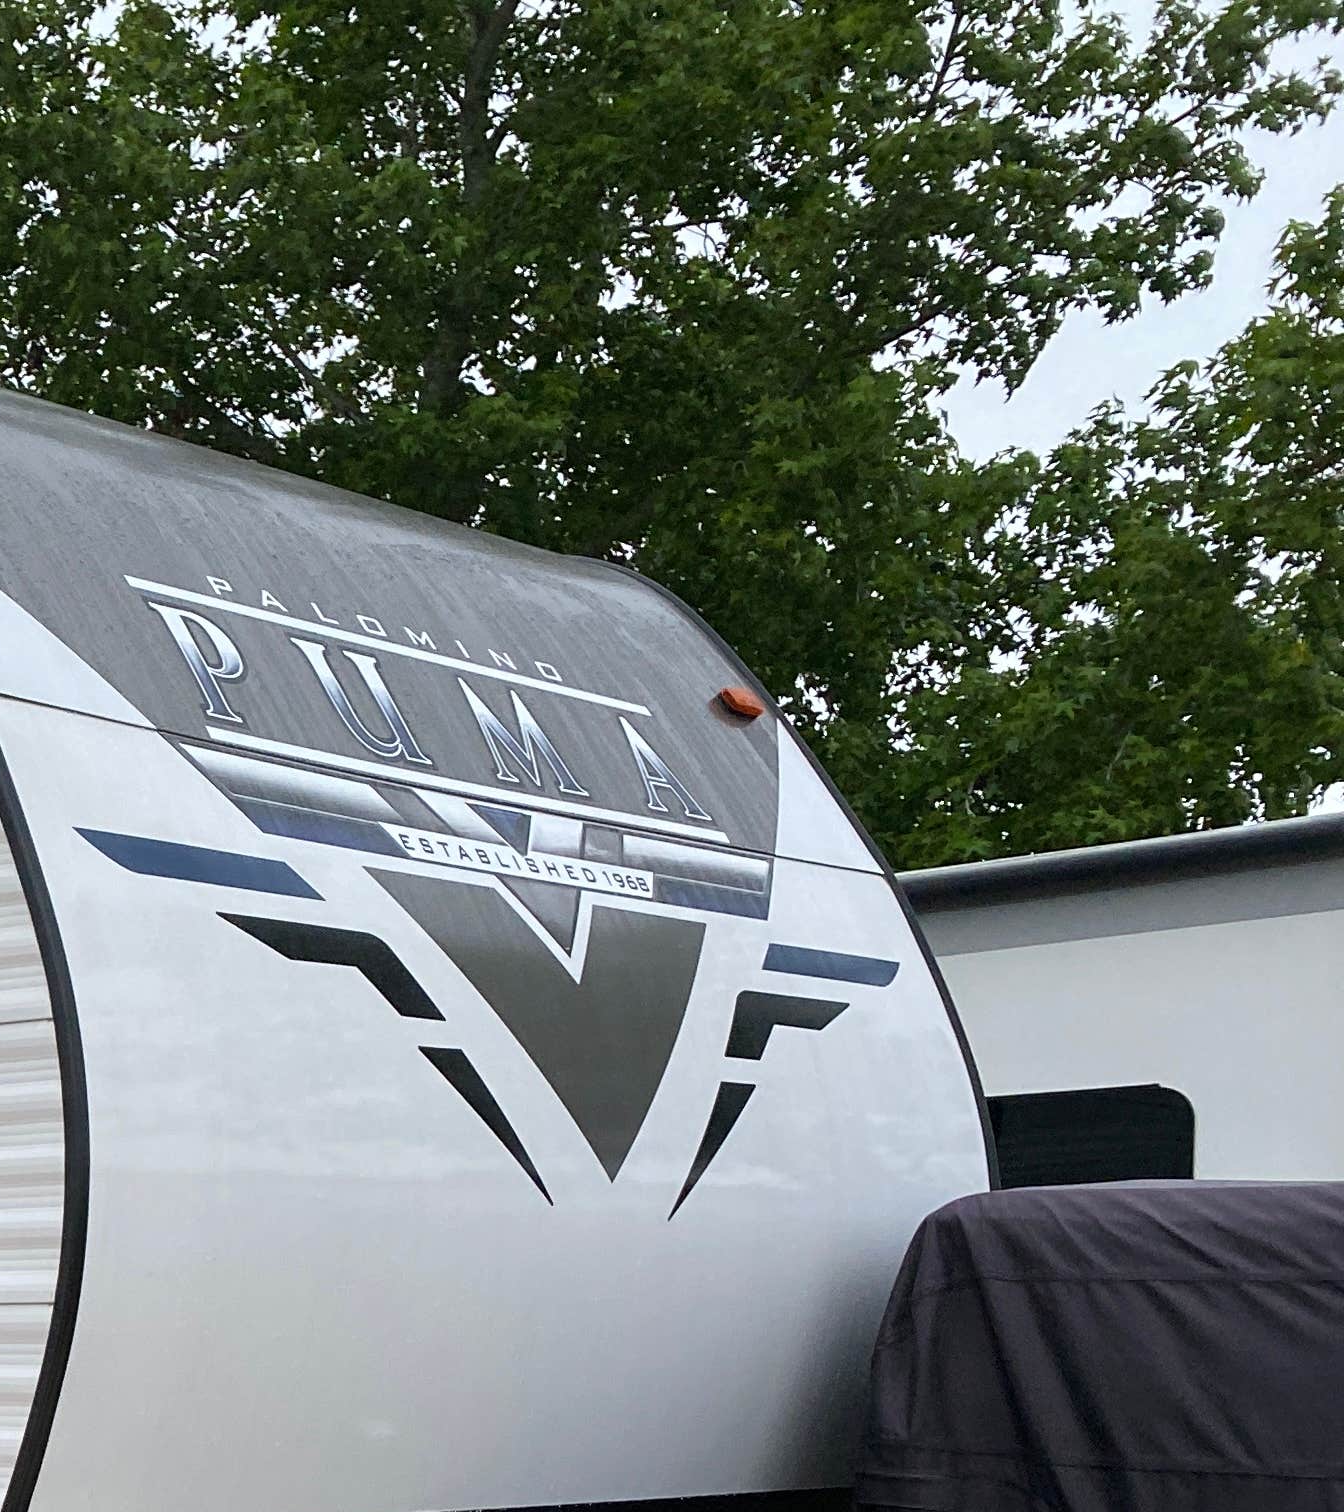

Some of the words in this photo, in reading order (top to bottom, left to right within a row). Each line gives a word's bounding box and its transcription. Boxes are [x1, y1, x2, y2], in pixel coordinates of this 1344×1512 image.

[206, 575, 563, 681] PALOMINO
[147, 601, 713, 821] PUMA
[398, 833, 597, 883] ESTABLISHED
[602, 870, 651, 892] 1968
